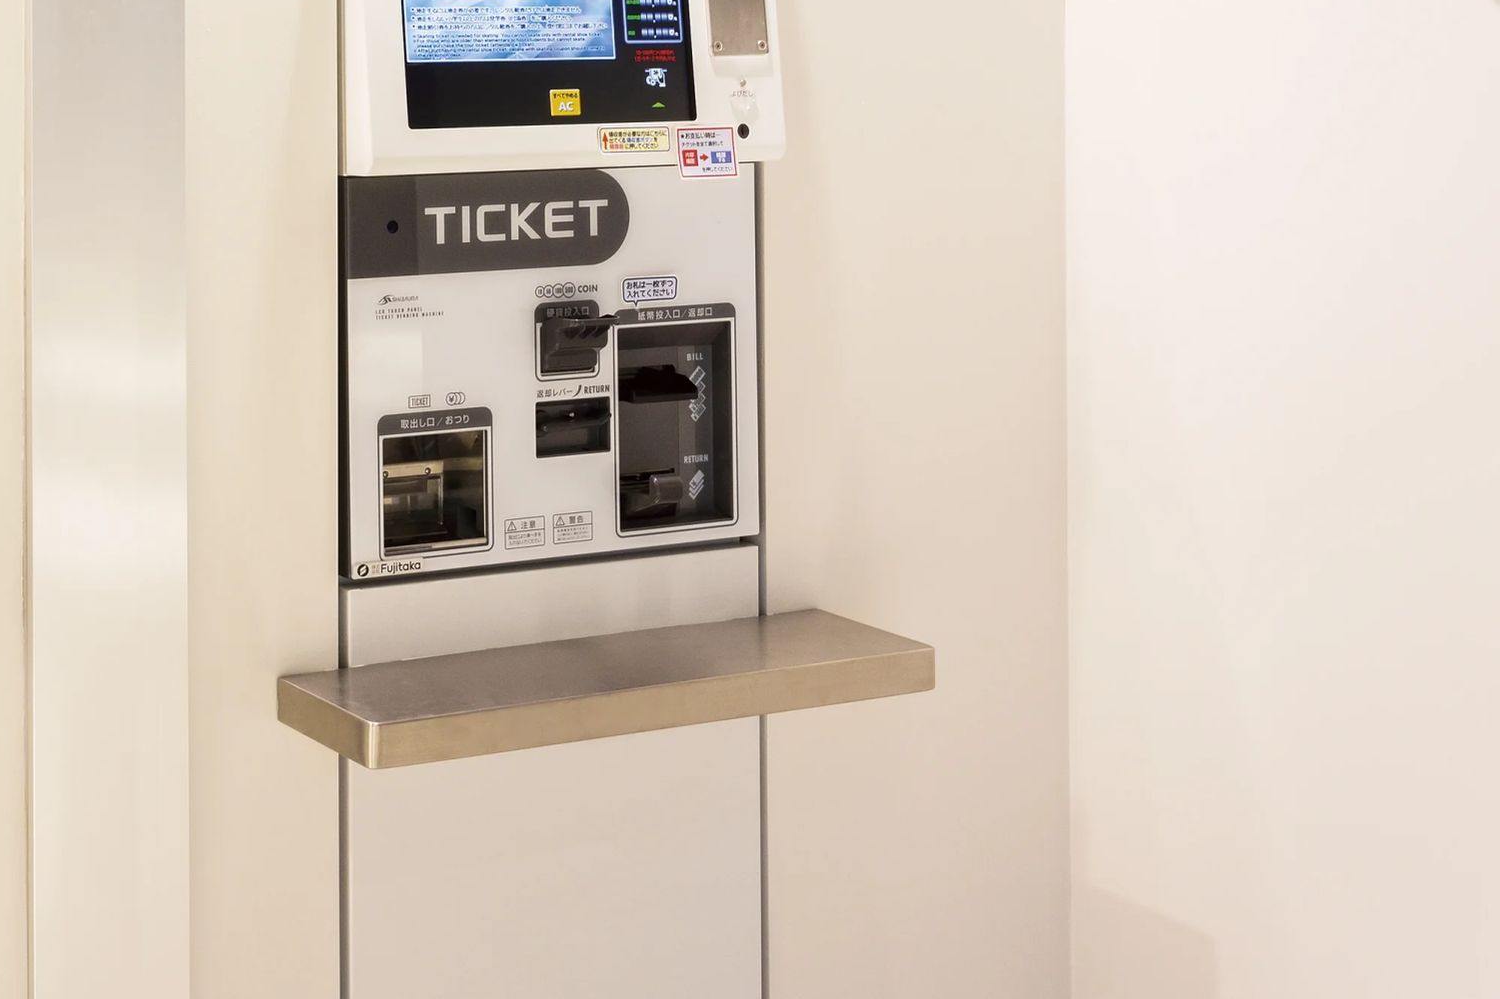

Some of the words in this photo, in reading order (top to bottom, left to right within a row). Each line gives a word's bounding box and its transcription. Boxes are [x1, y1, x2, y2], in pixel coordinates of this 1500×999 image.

[558, 101, 574, 112] AC
[424, 199, 608, 245] TICKET
[577, 284, 598, 294] COIN
[583, 385, 610, 394] RETURN
[683, 454, 709, 464] RETURN
[381, 561, 421, 574] Fujitaka
